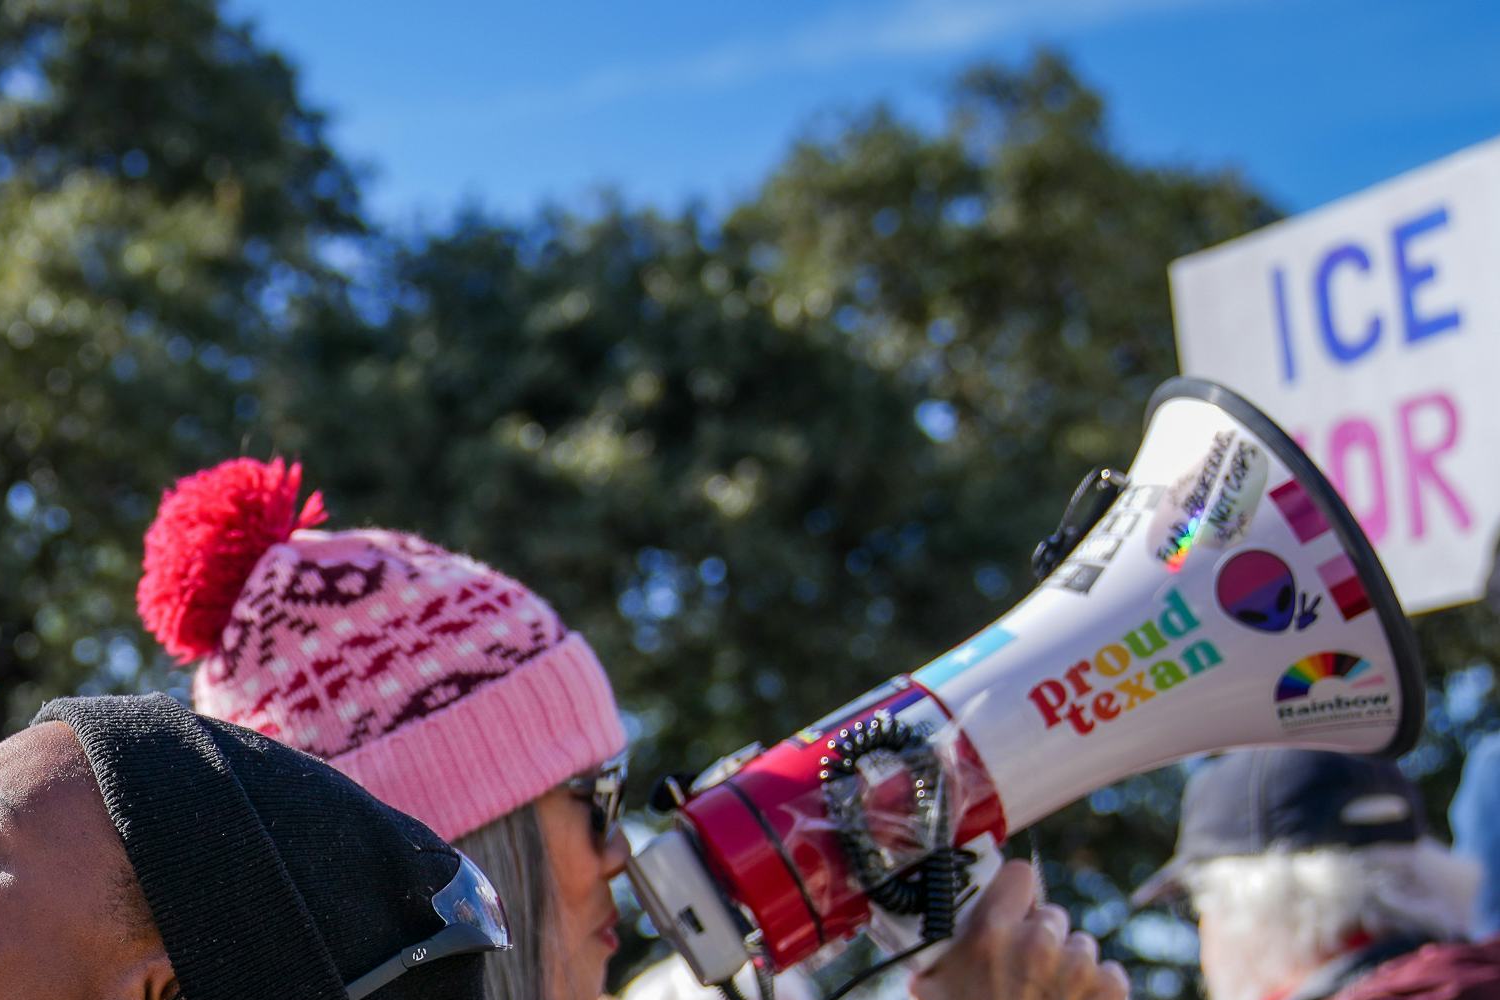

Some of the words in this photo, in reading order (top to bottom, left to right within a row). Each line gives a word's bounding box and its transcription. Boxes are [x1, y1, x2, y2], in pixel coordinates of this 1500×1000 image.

[1272, 206, 1462, 384] ICE
[1294, 391, 1473, 548] OR
[1028, 586, 1201, 731] proud
[1064, 639, 1224, 737] texan
